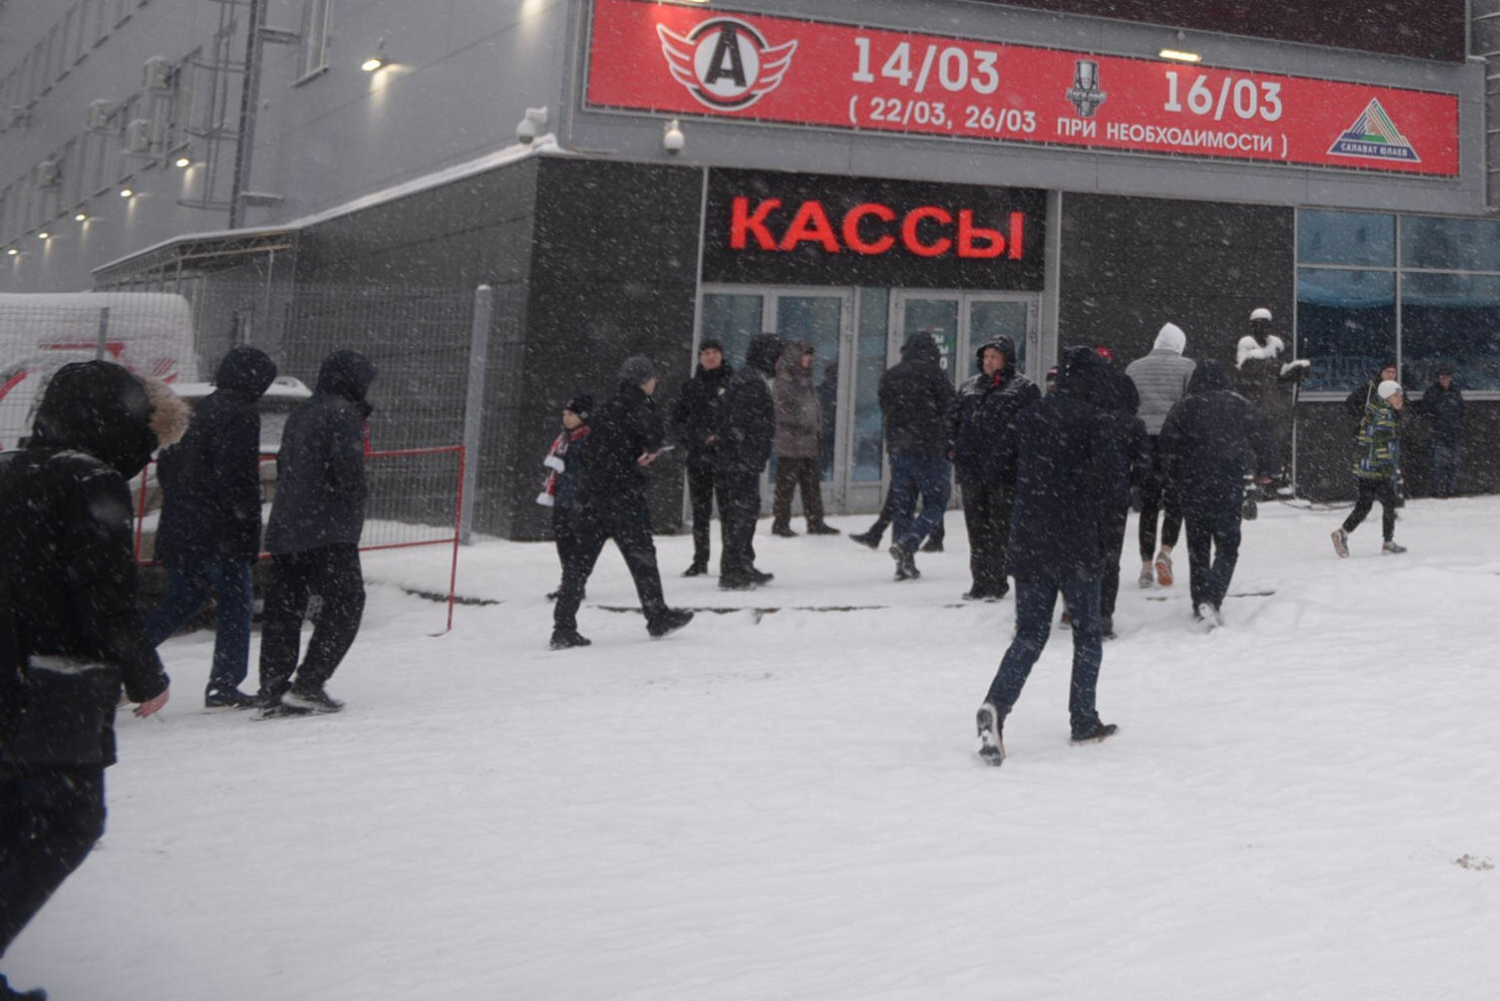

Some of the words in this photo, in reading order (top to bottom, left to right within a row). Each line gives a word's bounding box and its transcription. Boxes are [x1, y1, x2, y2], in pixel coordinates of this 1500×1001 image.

[851, 36, 1000, 95] 14/03
[1164, 71, 1283, 122] 16/03
[869, 97, 953, 130] 22/03,
[965, 104, 1037, 133] 26/03
[1057, 117, 1097, 139] ПРИ
[1106, 122, 1273, 153] НЕОБХОДИМОСТИ
[1340, 142, 1378, 154] САЛАВАТ
[1380, 146, 1408, 157] ЮЛАЕВ
[730, 195, 1025, 260] КАССЫ
